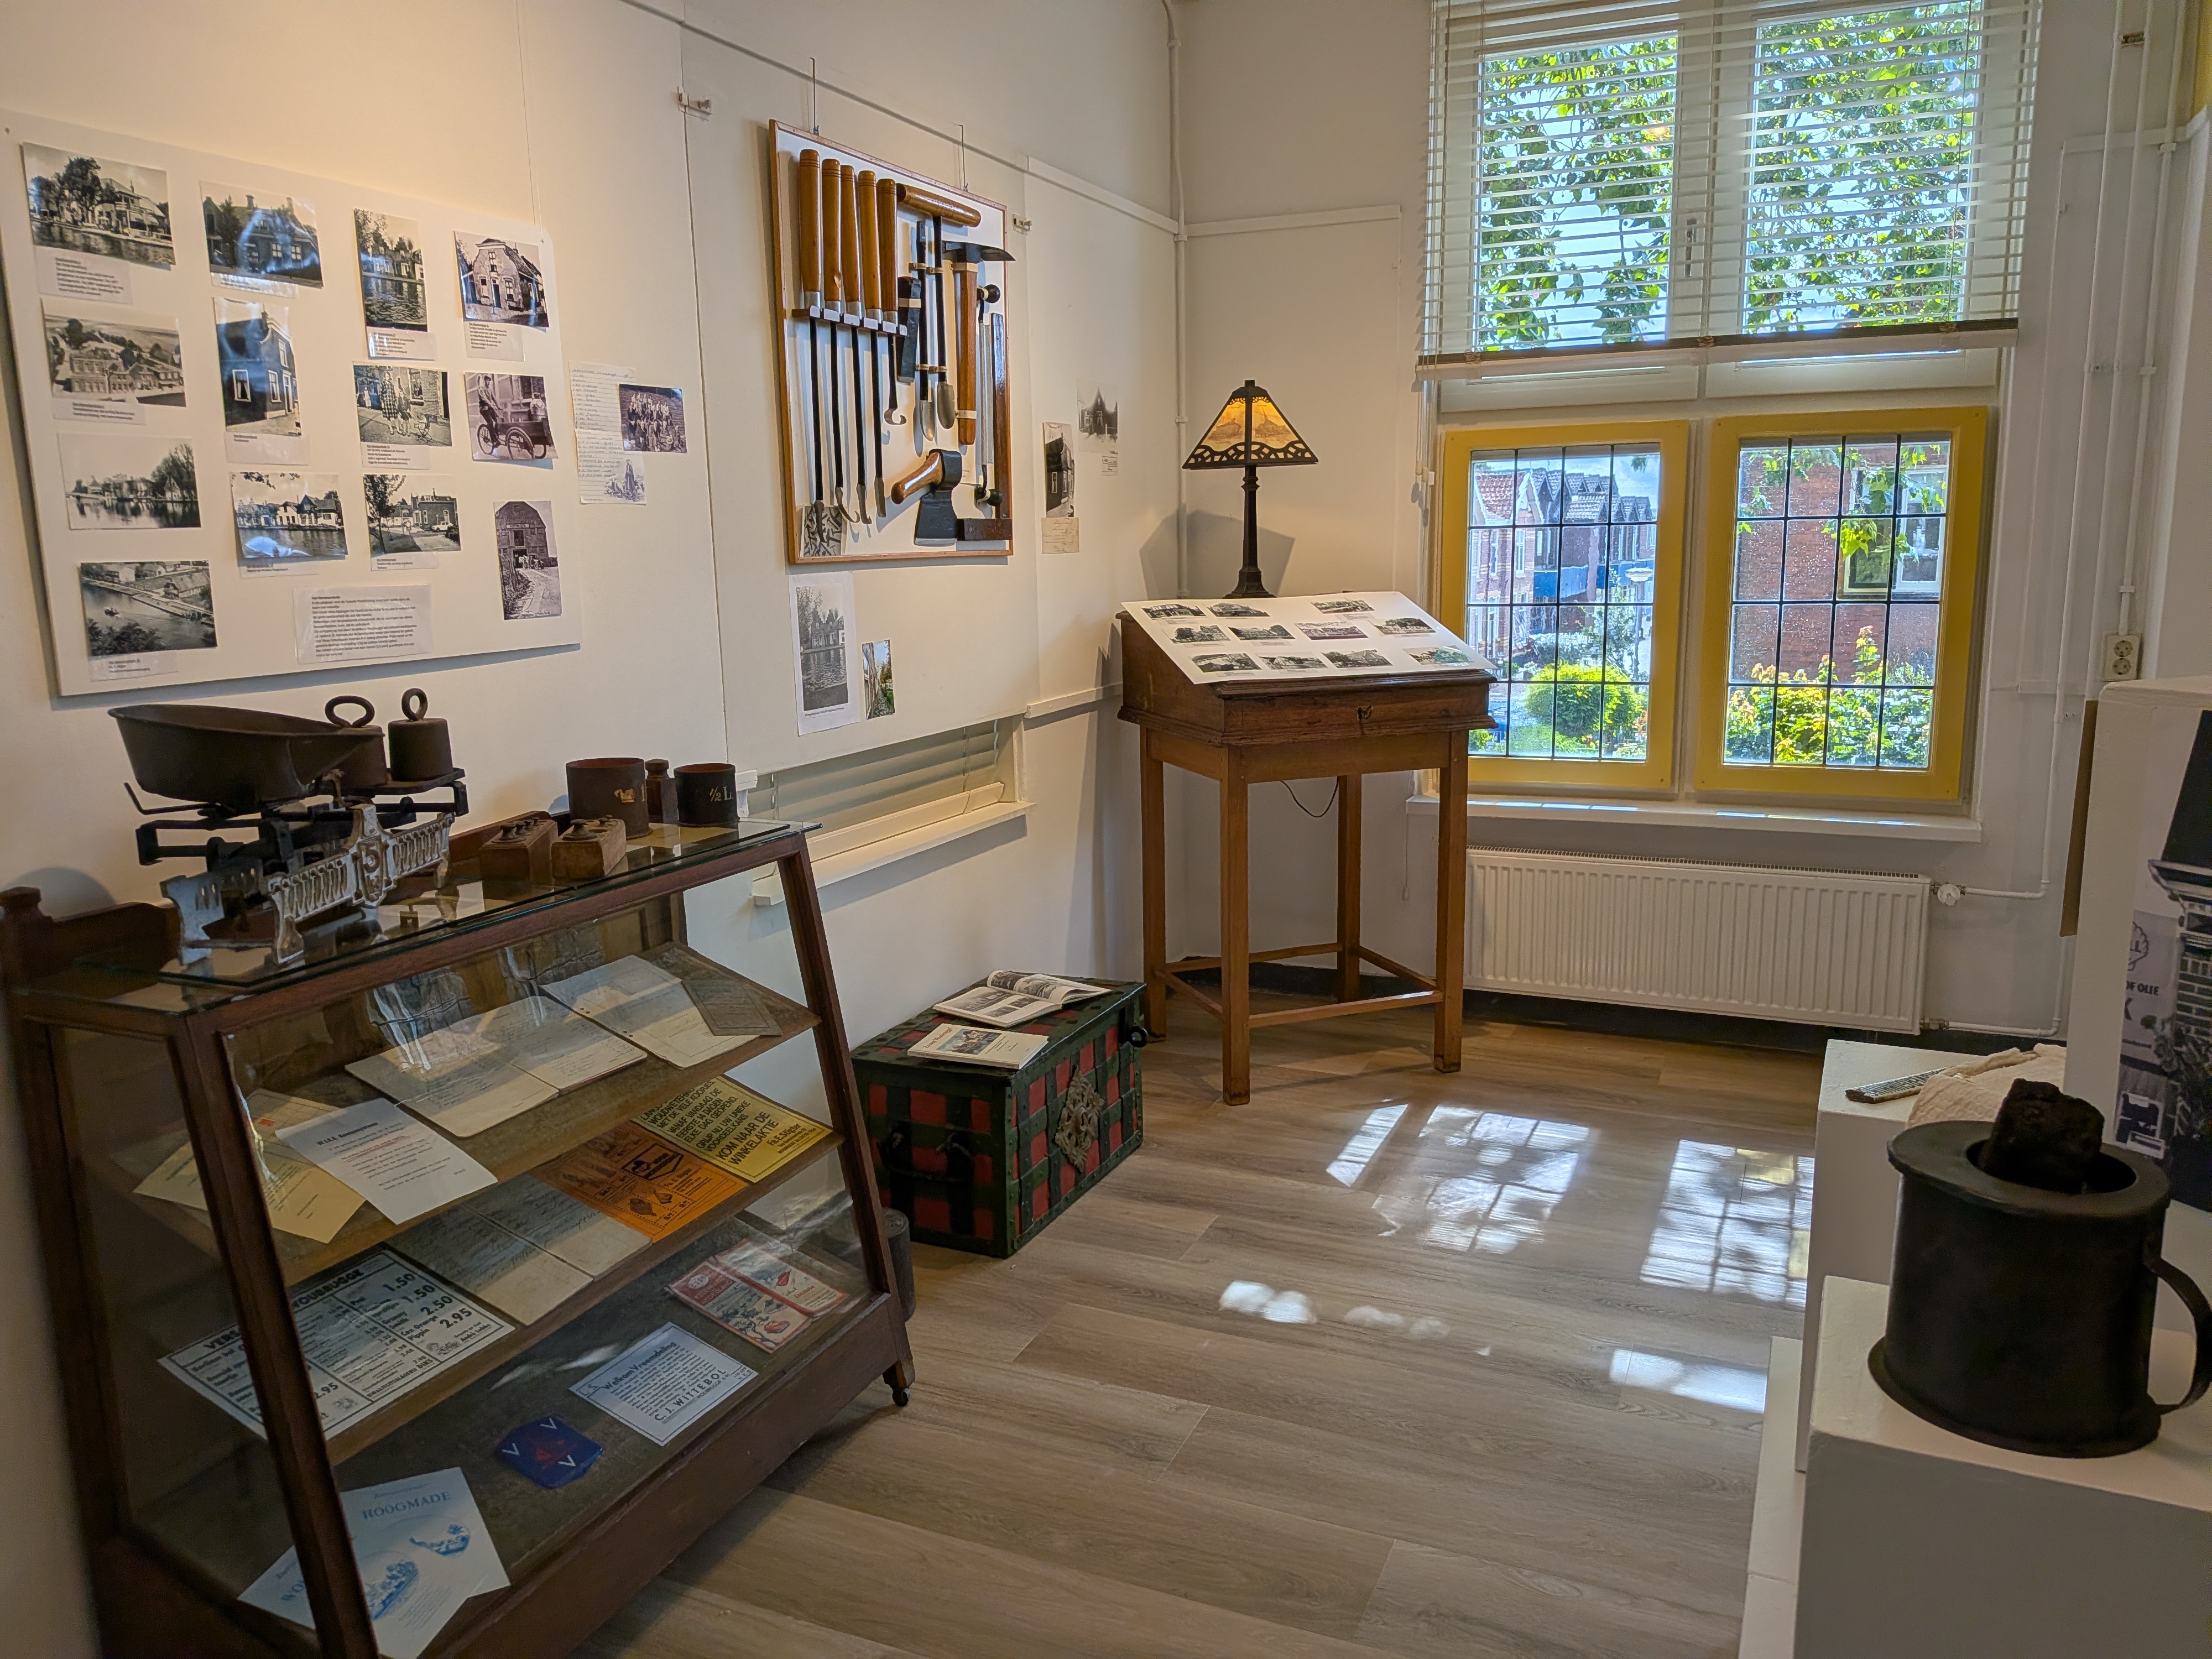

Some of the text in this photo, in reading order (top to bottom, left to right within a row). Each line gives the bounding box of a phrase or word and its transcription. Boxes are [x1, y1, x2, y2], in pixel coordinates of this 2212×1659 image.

[2137, 983, 2159, 996] OLIE
[656, 1117, 671, 1129] MET
[668, 1110, 680, 1119] DE
[676, 1099, 693, 1112] VELE
[666, 1088, 722, 1134] VANAF VANDAAG DE
[675, 1118, 701, 1139] EERSTE
[702, 1097, 723, 1115] DAGEN
[711, 1125, 723, 1135] NU
[719, 1116, 733, 1126] UW
[729, 1100, 751, 1118] UNIEKE
[683, 1129, 702, 1144] ELKE
[698, 1118, 714, 1130] DAG
[715, 1141, 739, 1161] KOM
[733, 1122, 760, 1144] NAAR
[754, 1111, 770, 1124] DE
[727, 1119, 779, 1165] WINKELAKTIE
[382, 1273, 416, 1292] 1.50
[400, 1284, 435, 1303] 1.50
[420, 1296, 453, 1316] 2.50
[439, 1307, 472, 1329] 2.95
[600, 1342, 677, 1390] Welkom Vreemdeling
[672, 1369, 727, 1406] WITTEBOL
[502, 1417, 557, 1455] V V
[558, 1454, 576, 1467] V
[362, 1491, 452, 1520] HOOGMADE
